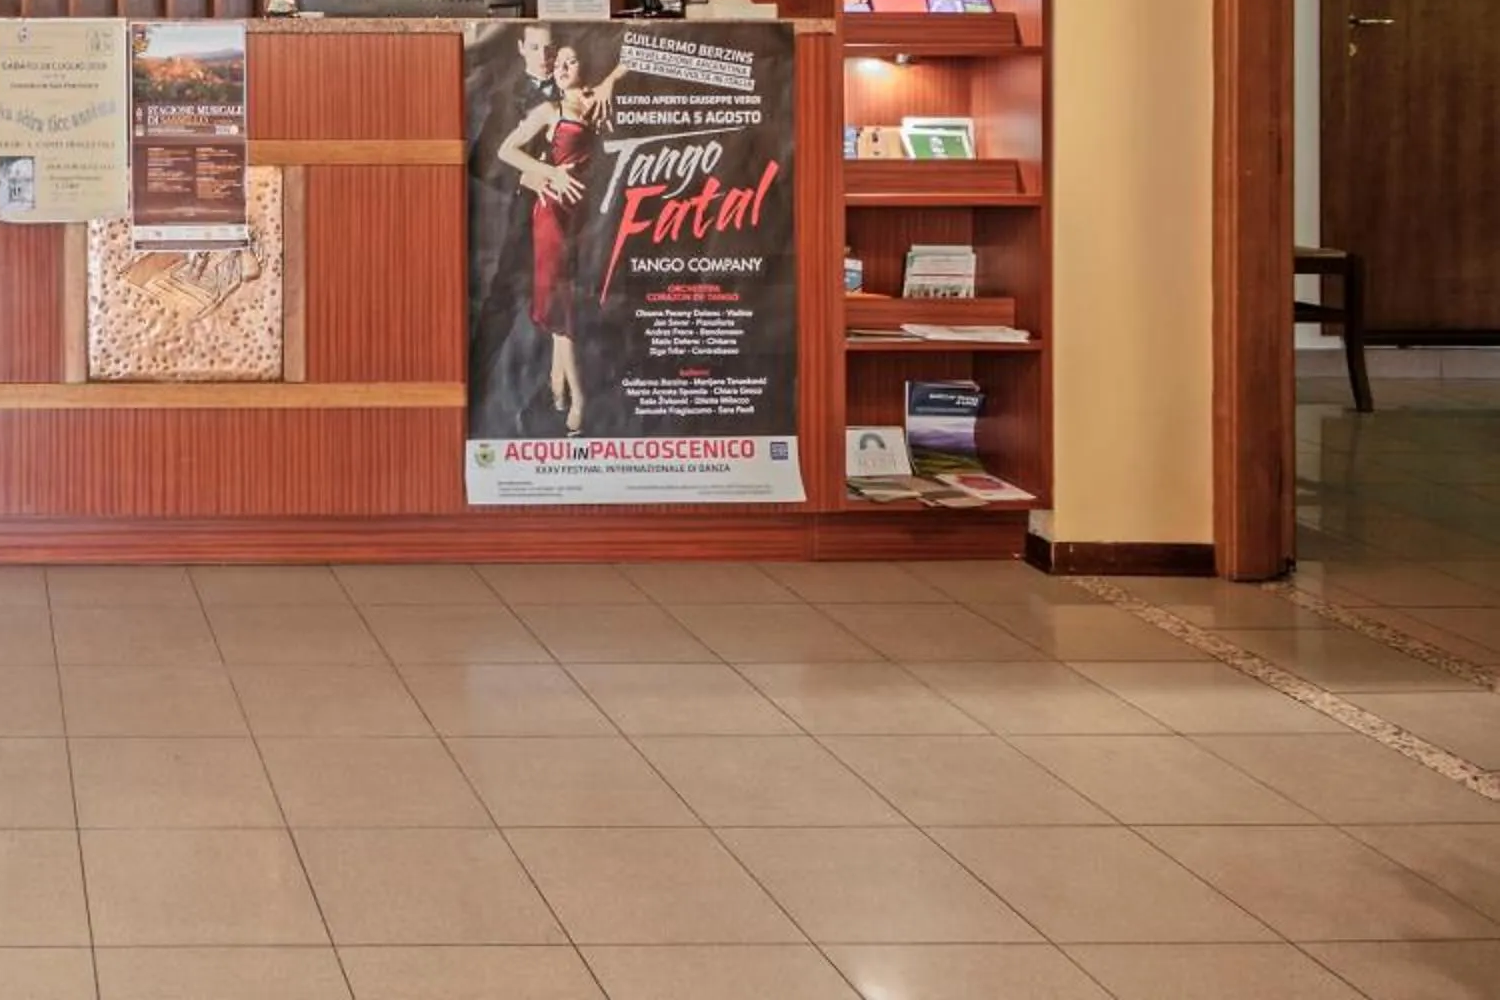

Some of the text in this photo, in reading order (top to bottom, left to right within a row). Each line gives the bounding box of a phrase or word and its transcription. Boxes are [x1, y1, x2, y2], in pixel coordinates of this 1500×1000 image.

[623, 32, 754, 64] GUILLERMO BERZINS
[616, 96, 651, 105] TEATRO
[617, 111, 761, 125] DOMENICA 5 AGOSTO
[600, 126, 746, 214] Tango
[600, 160, 779, 306] Fatal
[631, 258, 762, 272] TANGO COMPANY
[562, 465, 600, 474] FESTIVAL
[606, 464, 685, 473] INTERNAZIONALE
